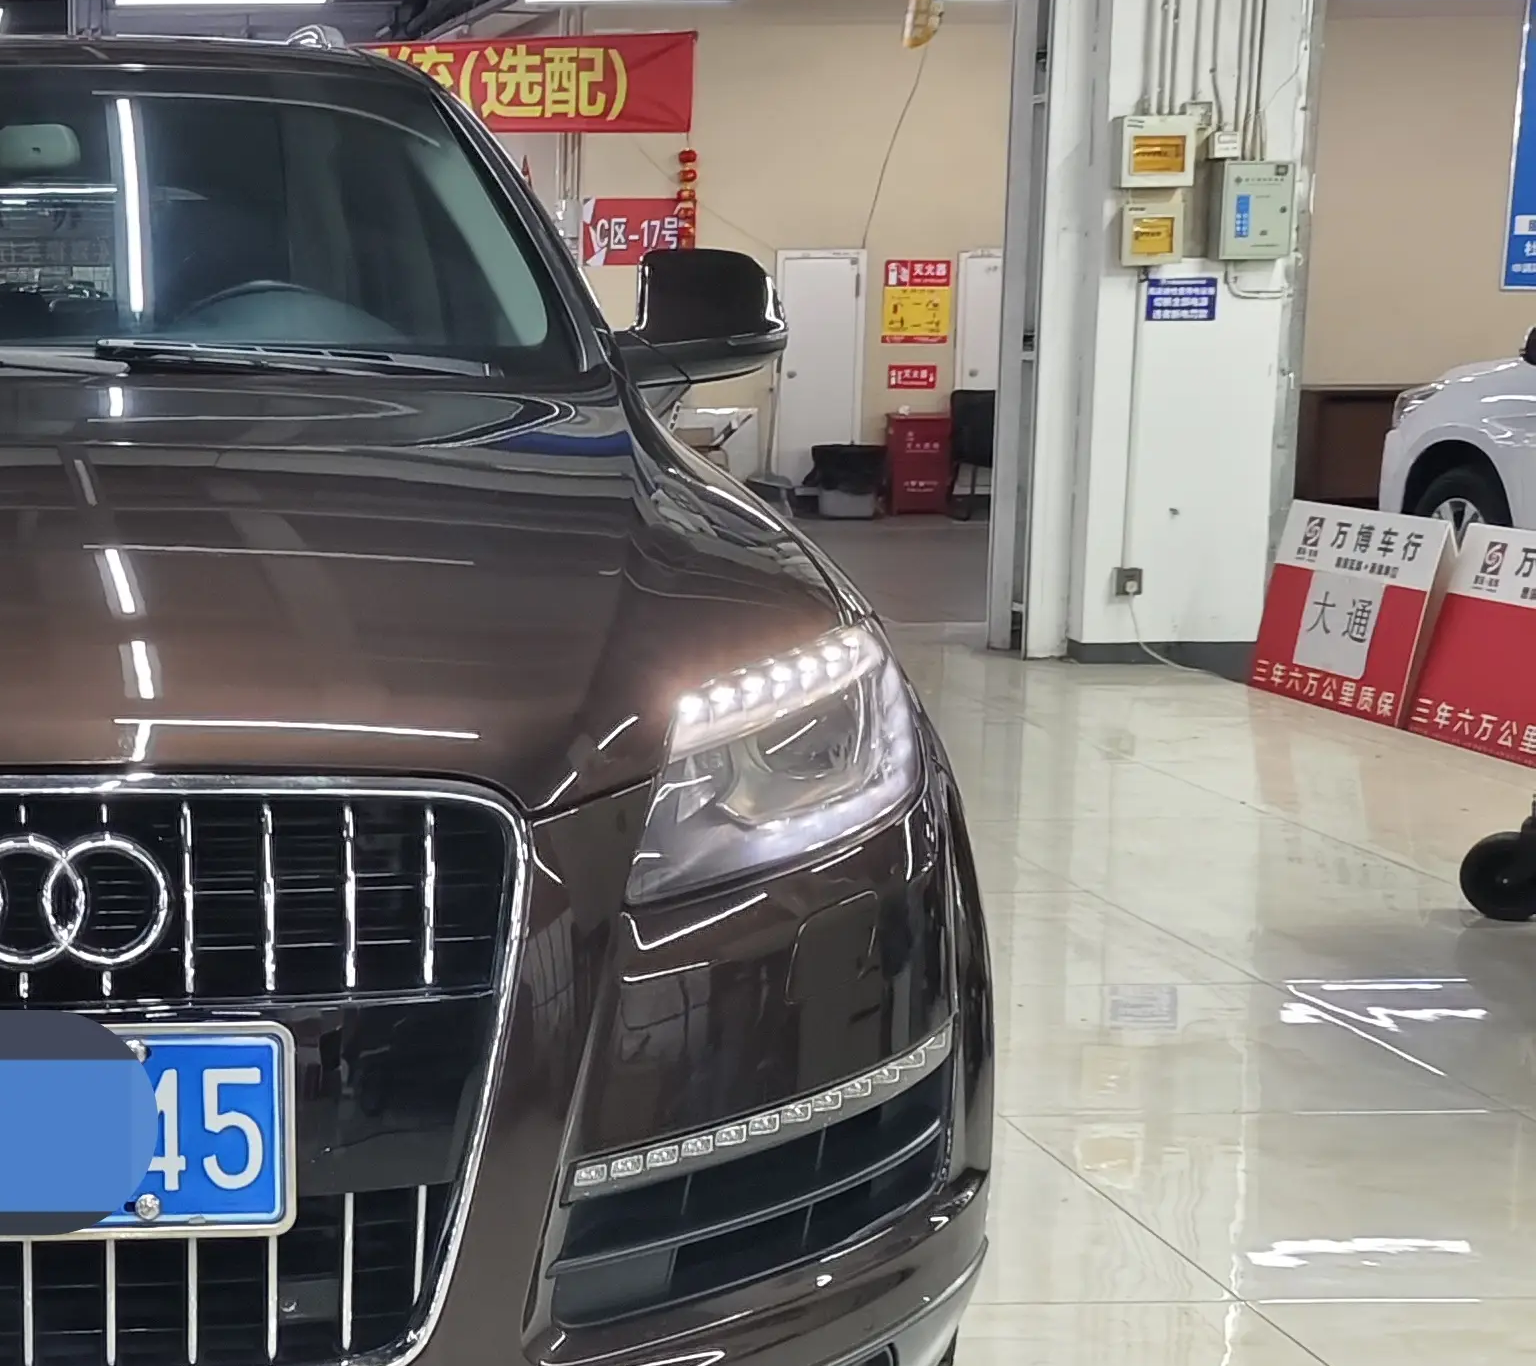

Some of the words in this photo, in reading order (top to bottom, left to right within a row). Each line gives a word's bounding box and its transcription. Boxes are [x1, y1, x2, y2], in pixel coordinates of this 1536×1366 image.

[596, 217, 679, 250] C区-17号
[1330, 521, 1424, 562] 万博车行
[1307, 591, 1373, 644] 大通
[1252, 659, 1395, 717] 三年六万公里质保
[1411, 698, 1536, 755] 三年六万公里
